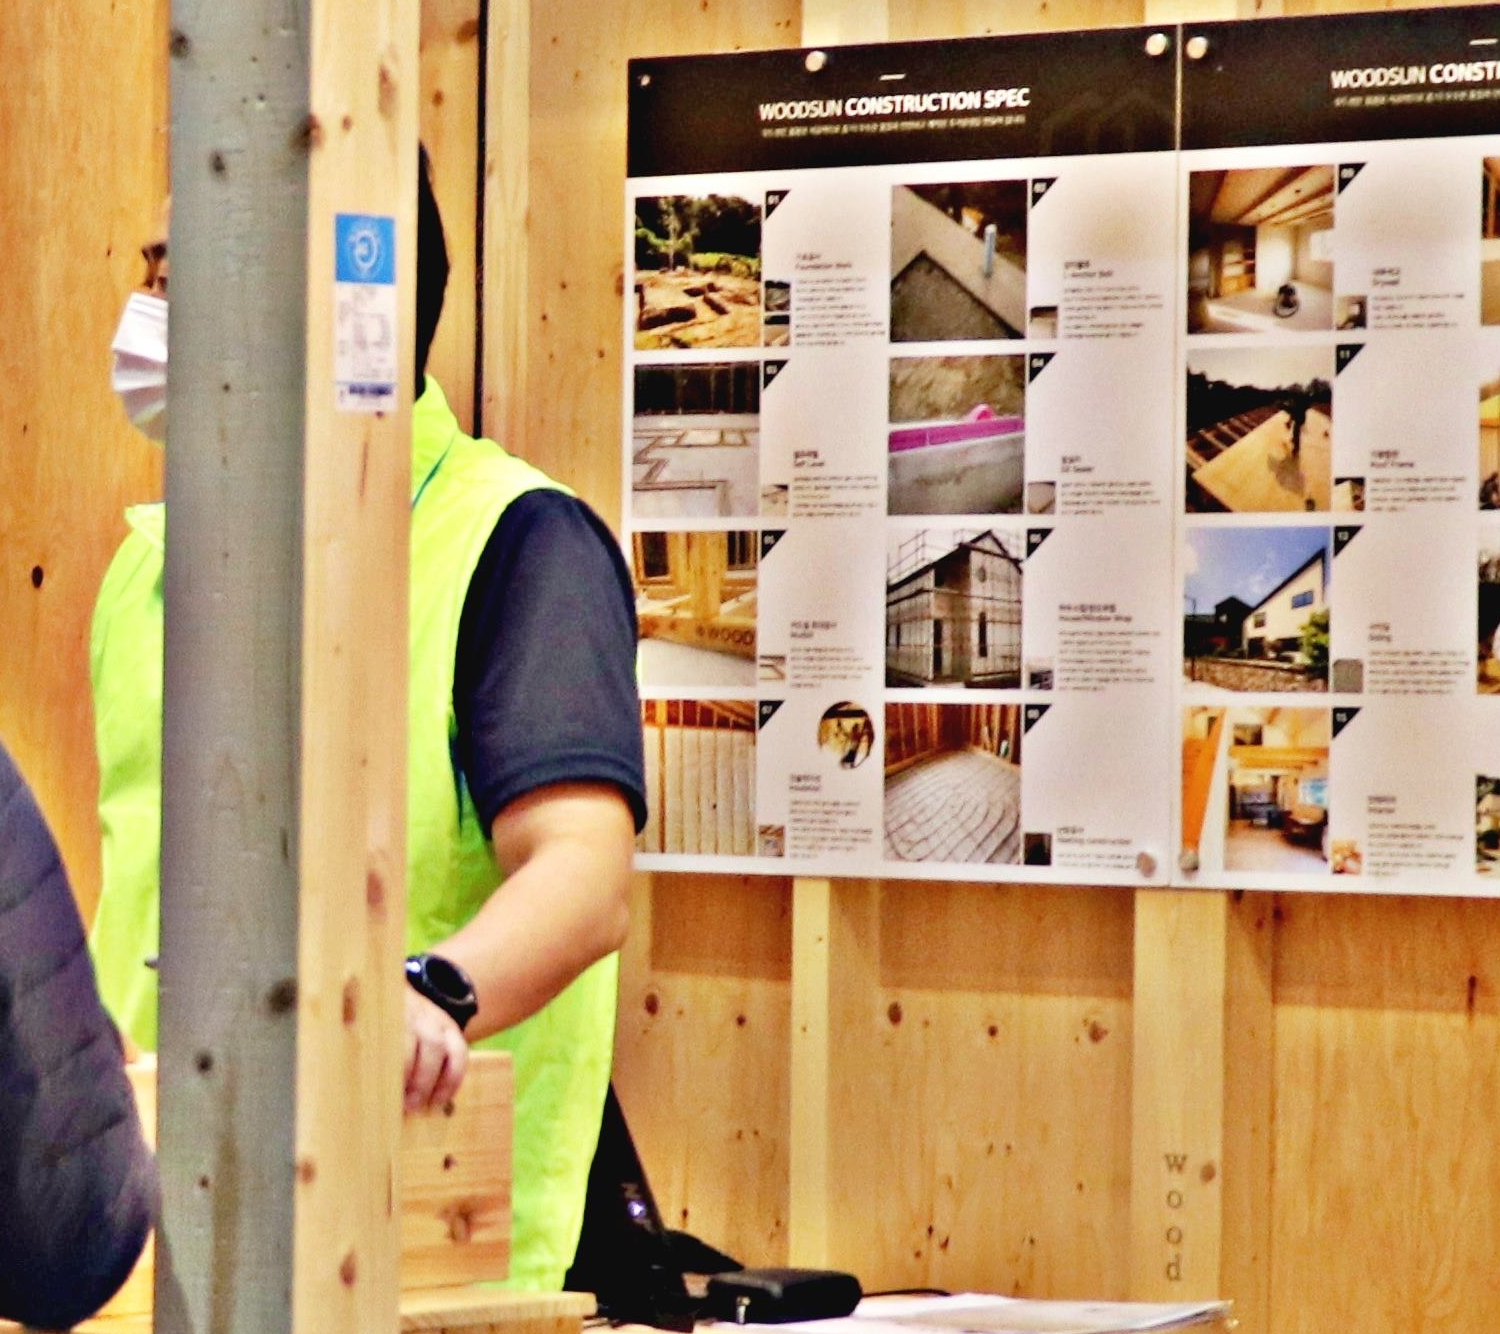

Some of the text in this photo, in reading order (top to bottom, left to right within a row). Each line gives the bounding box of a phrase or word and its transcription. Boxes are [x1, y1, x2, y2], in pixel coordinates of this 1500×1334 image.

[1330, 65, 1428, 89] WOODSUN
[759, 87, 1031, 121] WOODSUN CONSTRUCTION SPEC
[1166, 1154, 1188, 1281] wood
